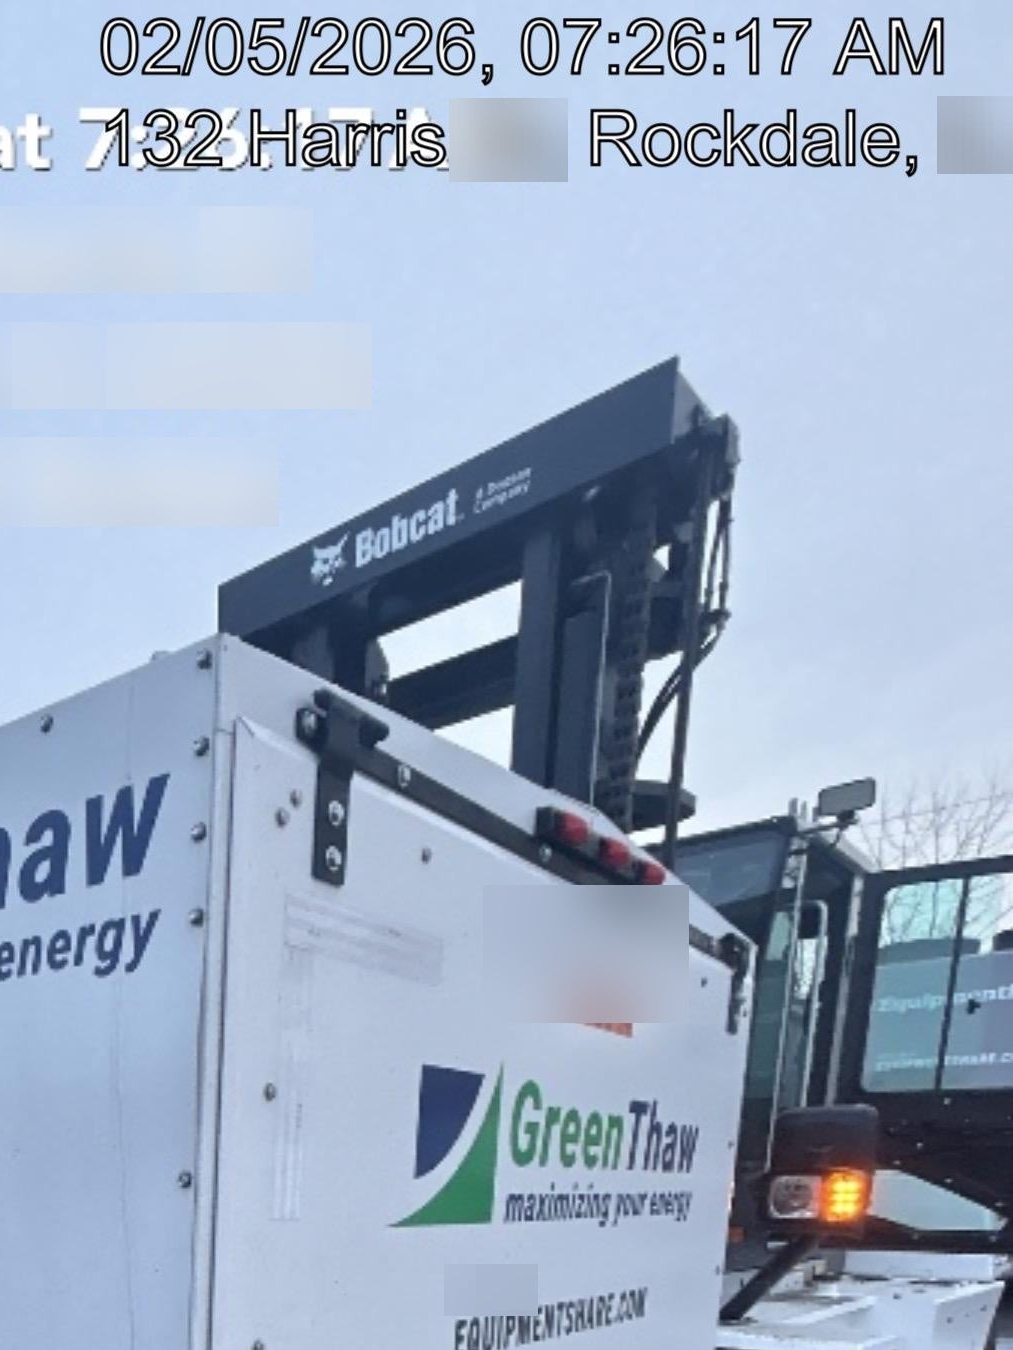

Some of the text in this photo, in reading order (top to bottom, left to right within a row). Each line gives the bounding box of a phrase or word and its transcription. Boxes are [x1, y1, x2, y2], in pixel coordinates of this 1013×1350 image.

[355, 488, 459, 568] Bobcat
[509, 1079, 699, 1173] GreenThaw
[503, 1182, 611, 1227] maximizing
[611, 1192, 645, 1227] your
